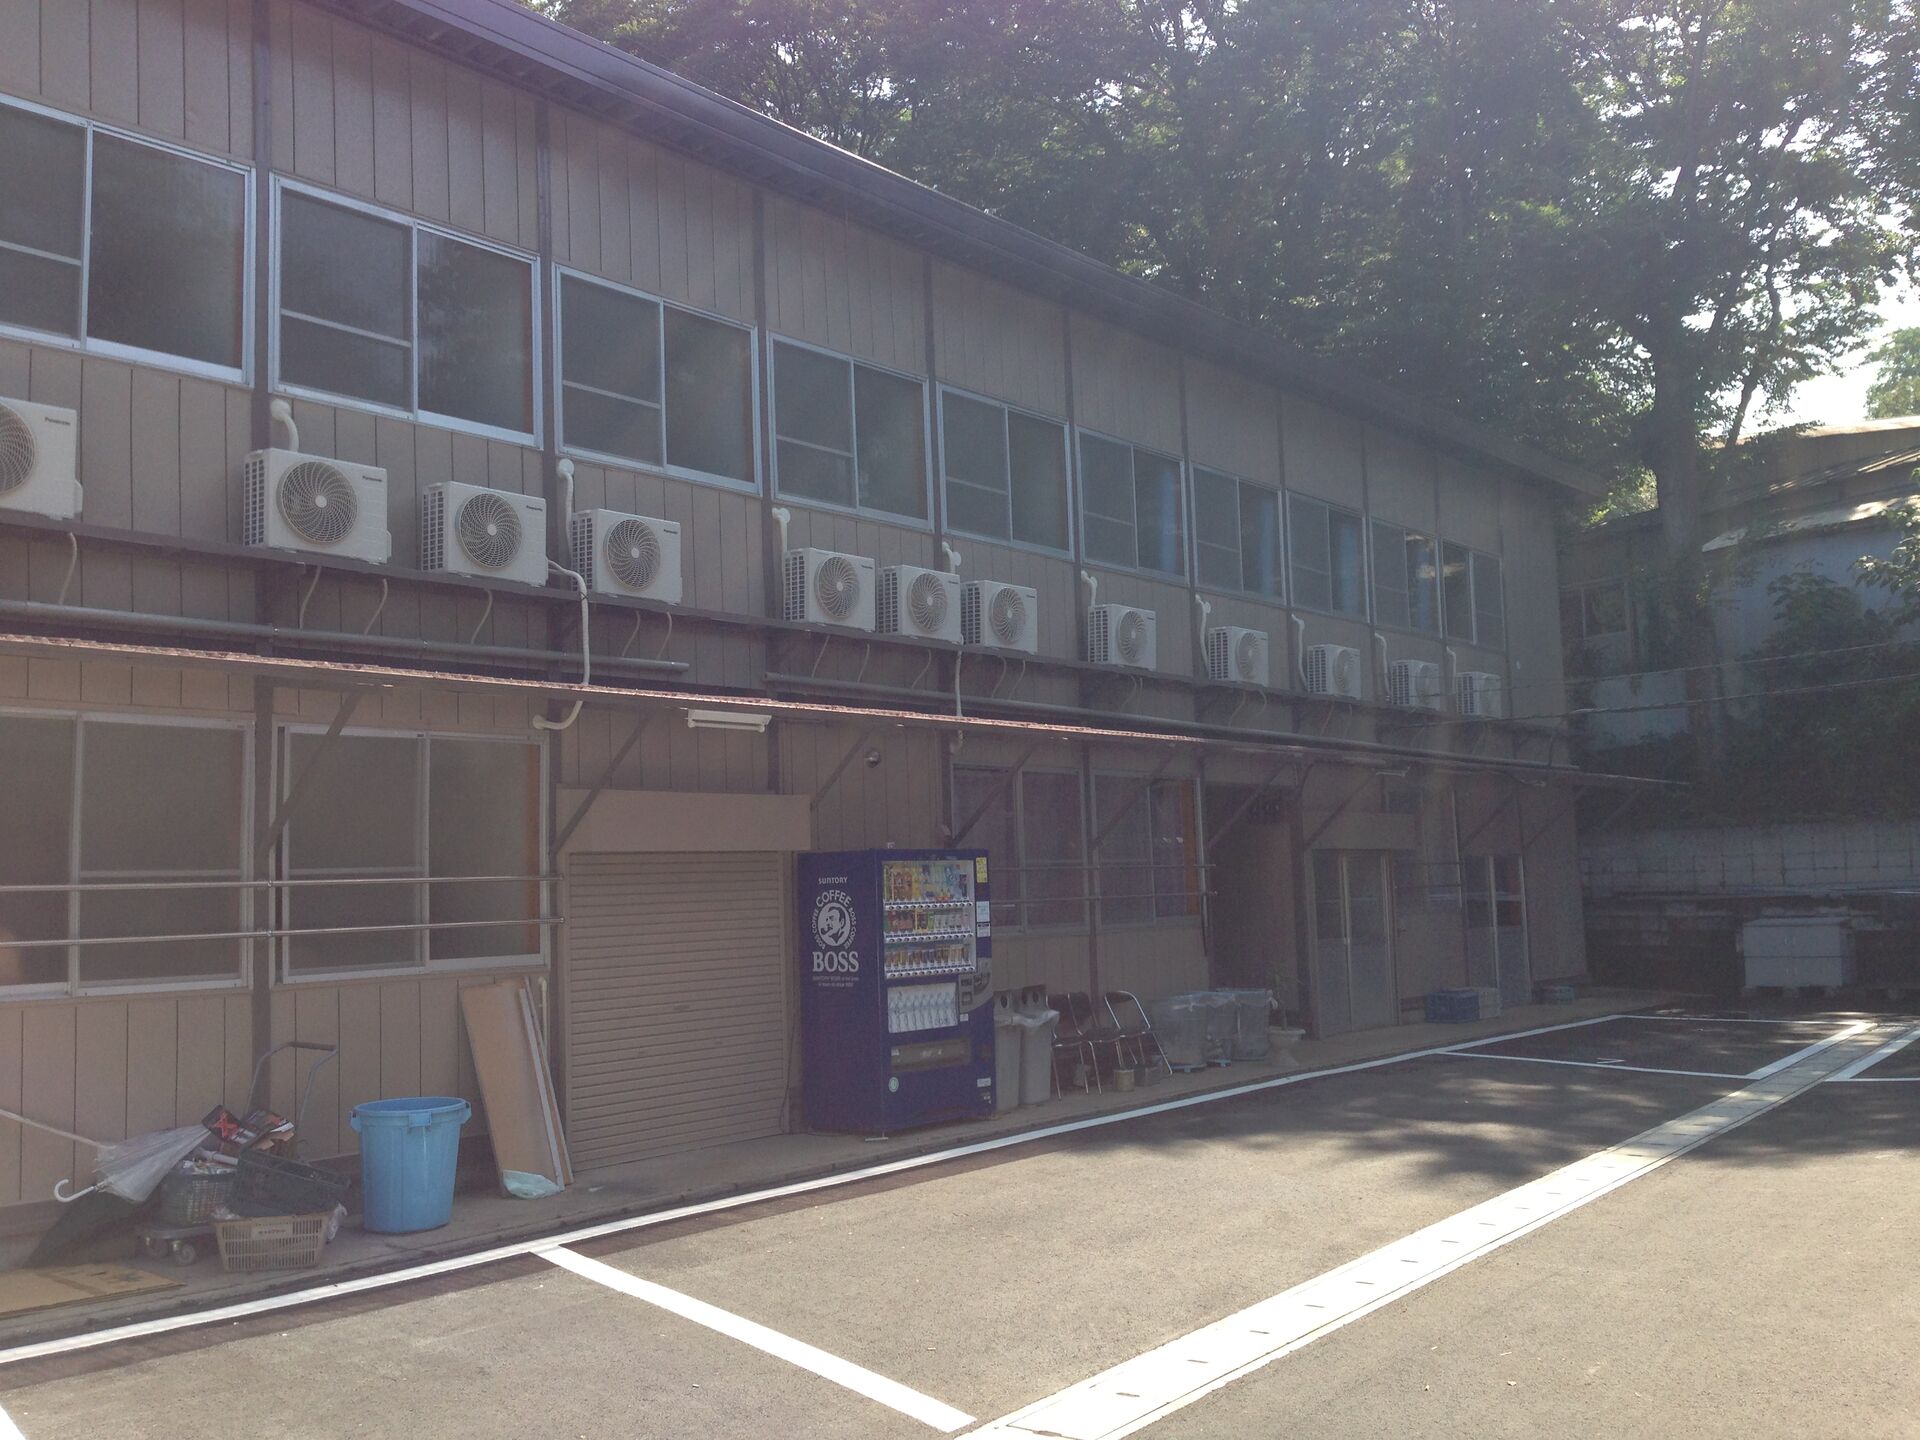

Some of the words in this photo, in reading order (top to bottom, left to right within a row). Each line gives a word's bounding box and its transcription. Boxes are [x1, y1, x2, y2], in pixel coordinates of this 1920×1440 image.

[818, 876, 848, 884] SUNTORY
[815, 889, 852, 908] COFFEE
[812, 950, 860, 973] BOSS
